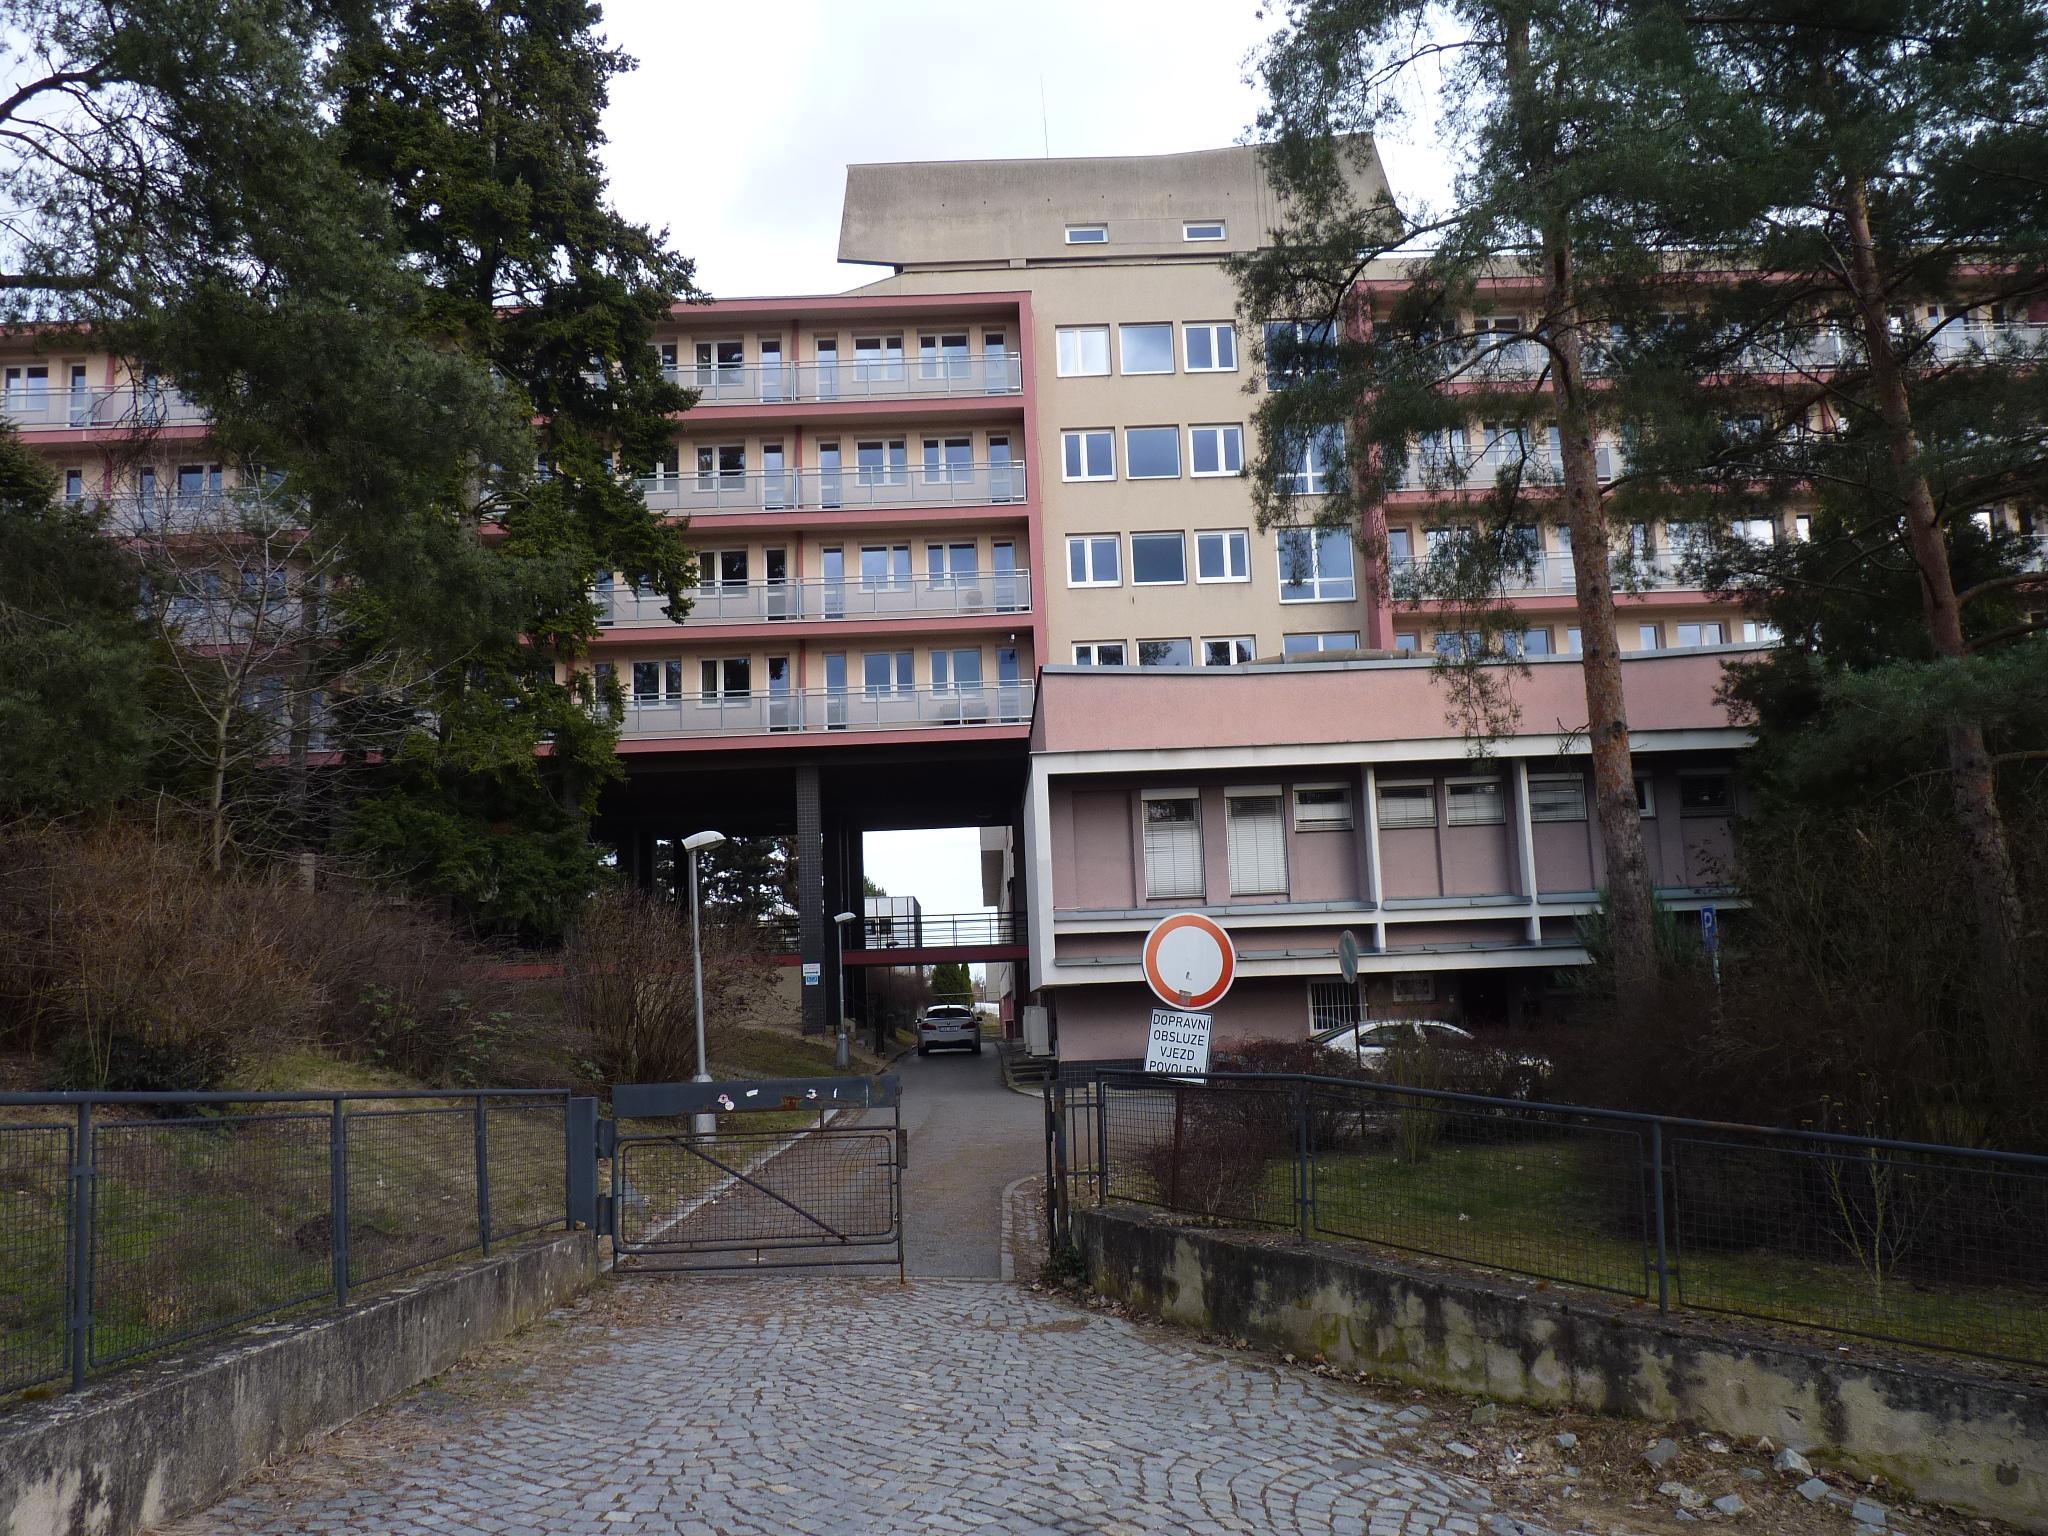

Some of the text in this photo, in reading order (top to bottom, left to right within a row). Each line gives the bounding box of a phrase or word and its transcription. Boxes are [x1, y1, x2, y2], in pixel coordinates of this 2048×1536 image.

[1152, 1013, 1211, 1031] DOPRAVNÍ
[1153, 1029, 1205, 1046] OBSLUZE
[1160, 1045, 1195, 1061] VJEZD
